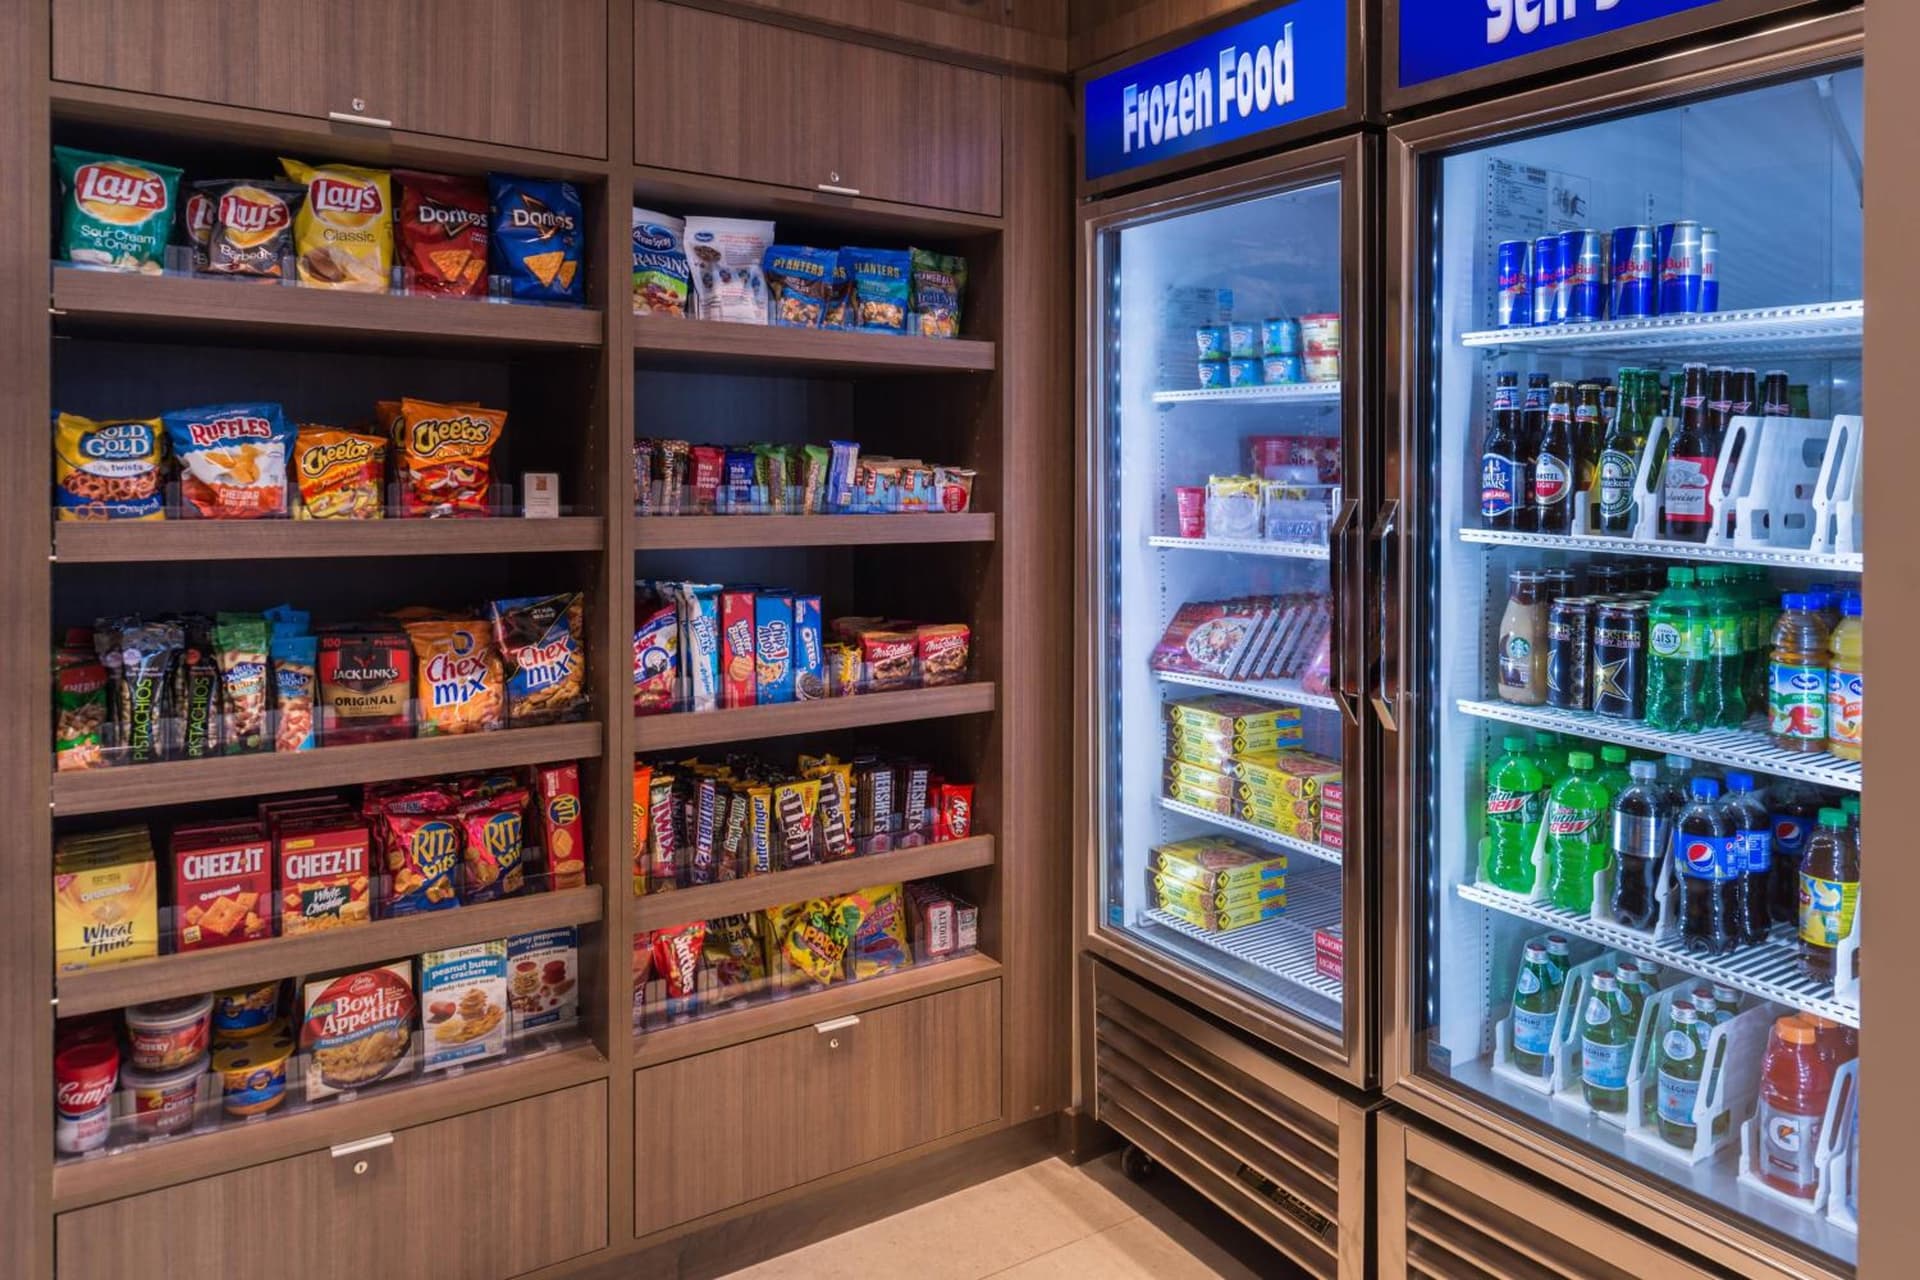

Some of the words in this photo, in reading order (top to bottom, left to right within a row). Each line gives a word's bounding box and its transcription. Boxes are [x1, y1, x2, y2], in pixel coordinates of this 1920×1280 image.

[1123, 66, 1213, 153] Frozen
[1219, 21, 1295, 123] Food
[81, 167, 161, 206] Lay's
[317, 180, 376, 213] Lay's
[81, 225, 113, 238] Sour
[114, 230, 156, 245] Cream
[104, 237, 142, 252] Onion
[323, 228, 375, 243] Classic
[86, 438, 149, 457] GOLD
[189, 417, 271, 445] RUFFLES
[413, 418, 489, 454] Cheetos
[302, 440, 370, 478] Cheetos
[801, 627, 816, 670] OREO
[334, 668, 361, 680] JACK
[426, 651, 486, 684] Chex
[334, 694, 397, 706] ORIGINAL
[434, 672, 490, 706] mix
[133, 679, 151, 761] PISTACHIOS
[188, 676, 209, 757] PISTACHIOS
[554, 797, 576, 825] RITZ
[651, 799, 674, 860] TWIX
[753, 797, 768, 873] Butterfinger
[413, 828, 456, 865] RITZ
[83, 921, 133, 944] Wheat
[431, 963, 466, 980] peanut
[468, 959, 498, 972] butter
[674, 934, 695, 994] Skittles
[335, 987, 385, 1018] Bowl
